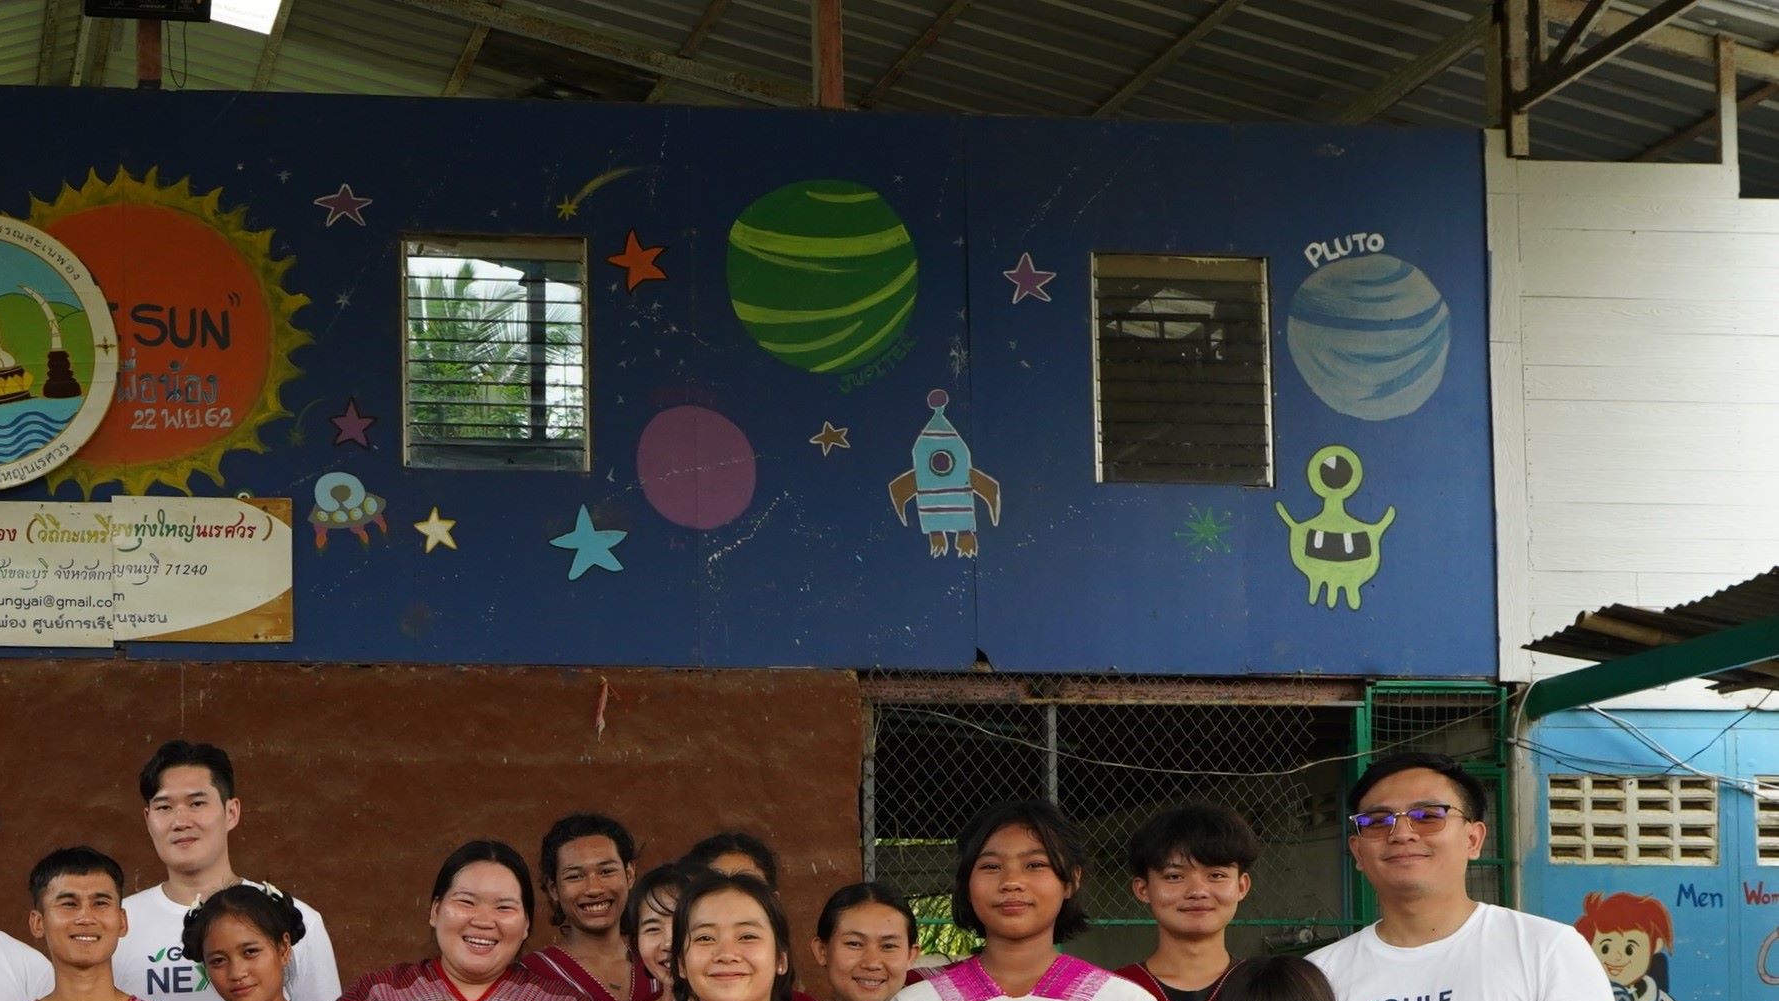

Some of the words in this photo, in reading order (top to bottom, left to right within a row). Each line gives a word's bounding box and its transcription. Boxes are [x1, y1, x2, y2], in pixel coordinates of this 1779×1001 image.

[1304, 232, 1385, 269] PLUTO
[164, 562, 208, 577] 71240
[1676, 883, 1724, 908] Men
[147, 966, 213, 996] NE
